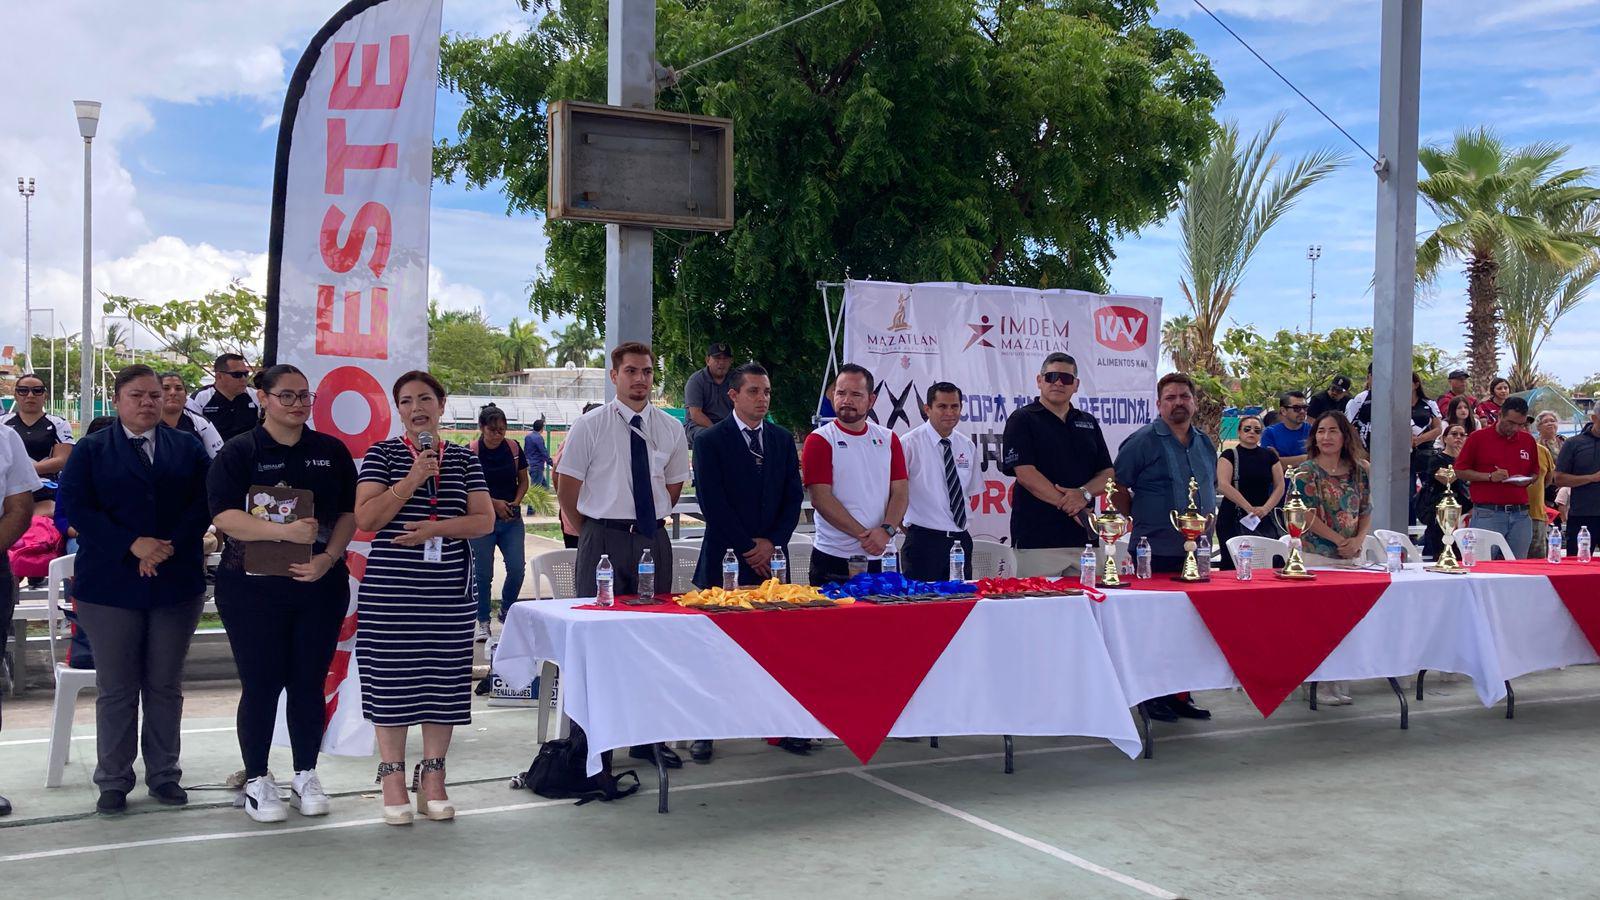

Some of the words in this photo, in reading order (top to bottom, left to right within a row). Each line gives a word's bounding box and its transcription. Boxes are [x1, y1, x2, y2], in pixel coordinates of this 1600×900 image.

[1001, 316, 1069, 337] IMDEM
[1099, 315, 1144, 342] KAY
[1097, 358, 1135, 367] ALIMENTOS
[960, 394, 1008, 422] COPA
[1079, 398, 1152, 425] REGIONAL
